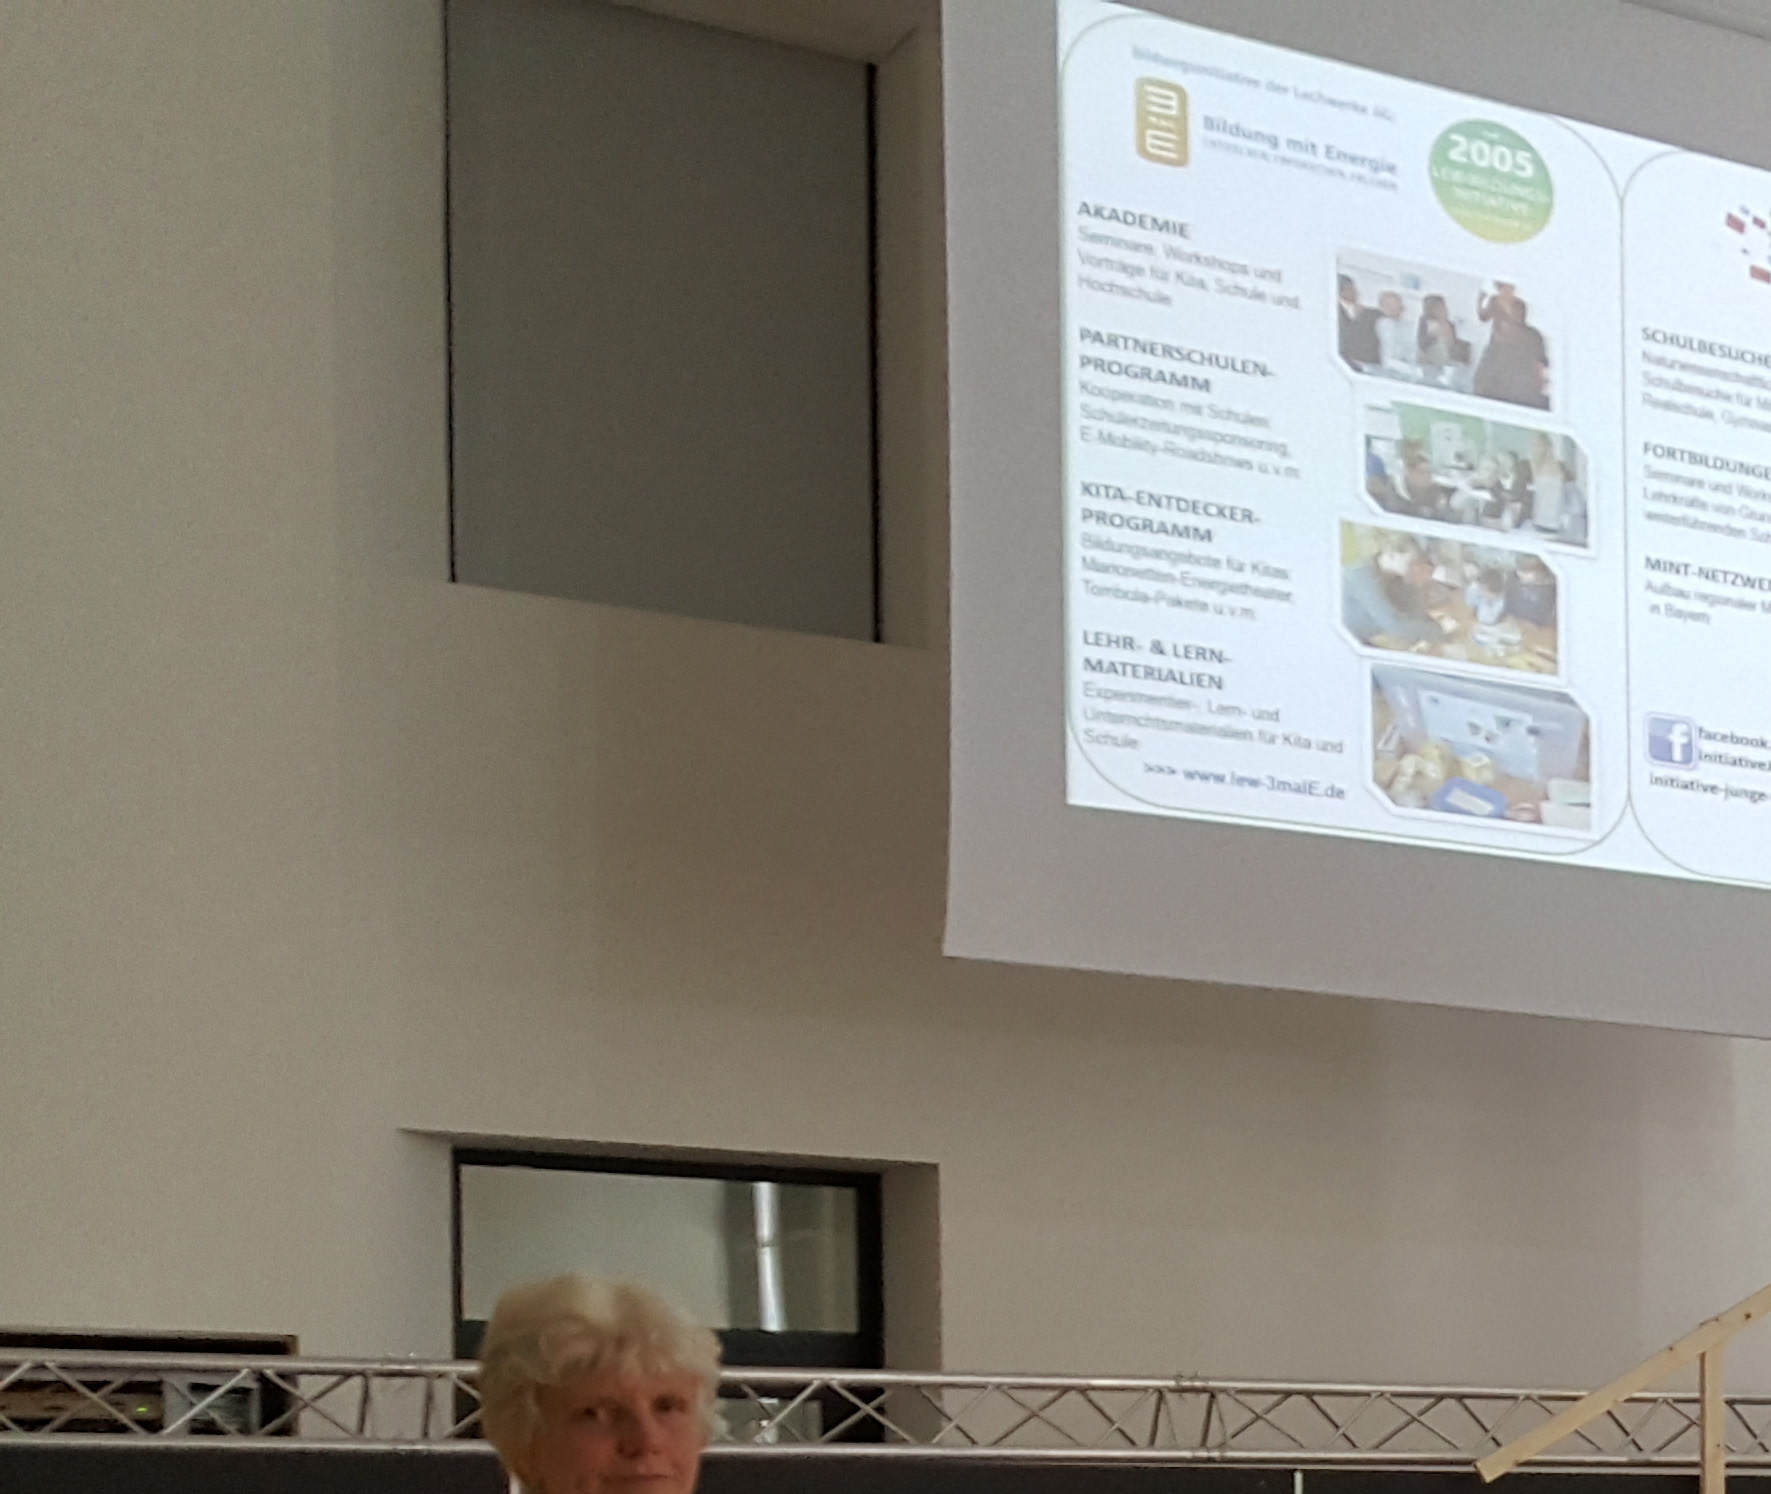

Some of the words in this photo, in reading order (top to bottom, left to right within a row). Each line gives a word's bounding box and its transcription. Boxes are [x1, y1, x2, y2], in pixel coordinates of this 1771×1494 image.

[1203, 114, 1279, 149] Bildung
[1286, 134, 1319, 157] mit
[1324, 144, 1397, 176] Energie
[1447, 132, 1535, 179] 2005
[1077, 201, 1191, 239] AKADEMIE
[1080, 326, 1278, 378] PARTNERSCHULEN-
[1080, 355, 1212, 393] PROGRAMM
[1080, 481, 1262, 524] KITA-ENTDECKER-
[1081, 507, 1213, 543] PROGRAMM
[1663, 602, 1711, 625] Bayern
[1082, 629, 1143, 651] LEHR-
[1149, 638, 1166, 656] &
[1172, 643, 1232, 664] LERN-
[1083, 657, 1224, 691] MATERIALIEN
[1251, 705, 1280, 722] und
[1083, 727, 1139, 750] Schule
[1282, 731, 1312, 750] Kita
[1315, 737, 1344, 755] und
